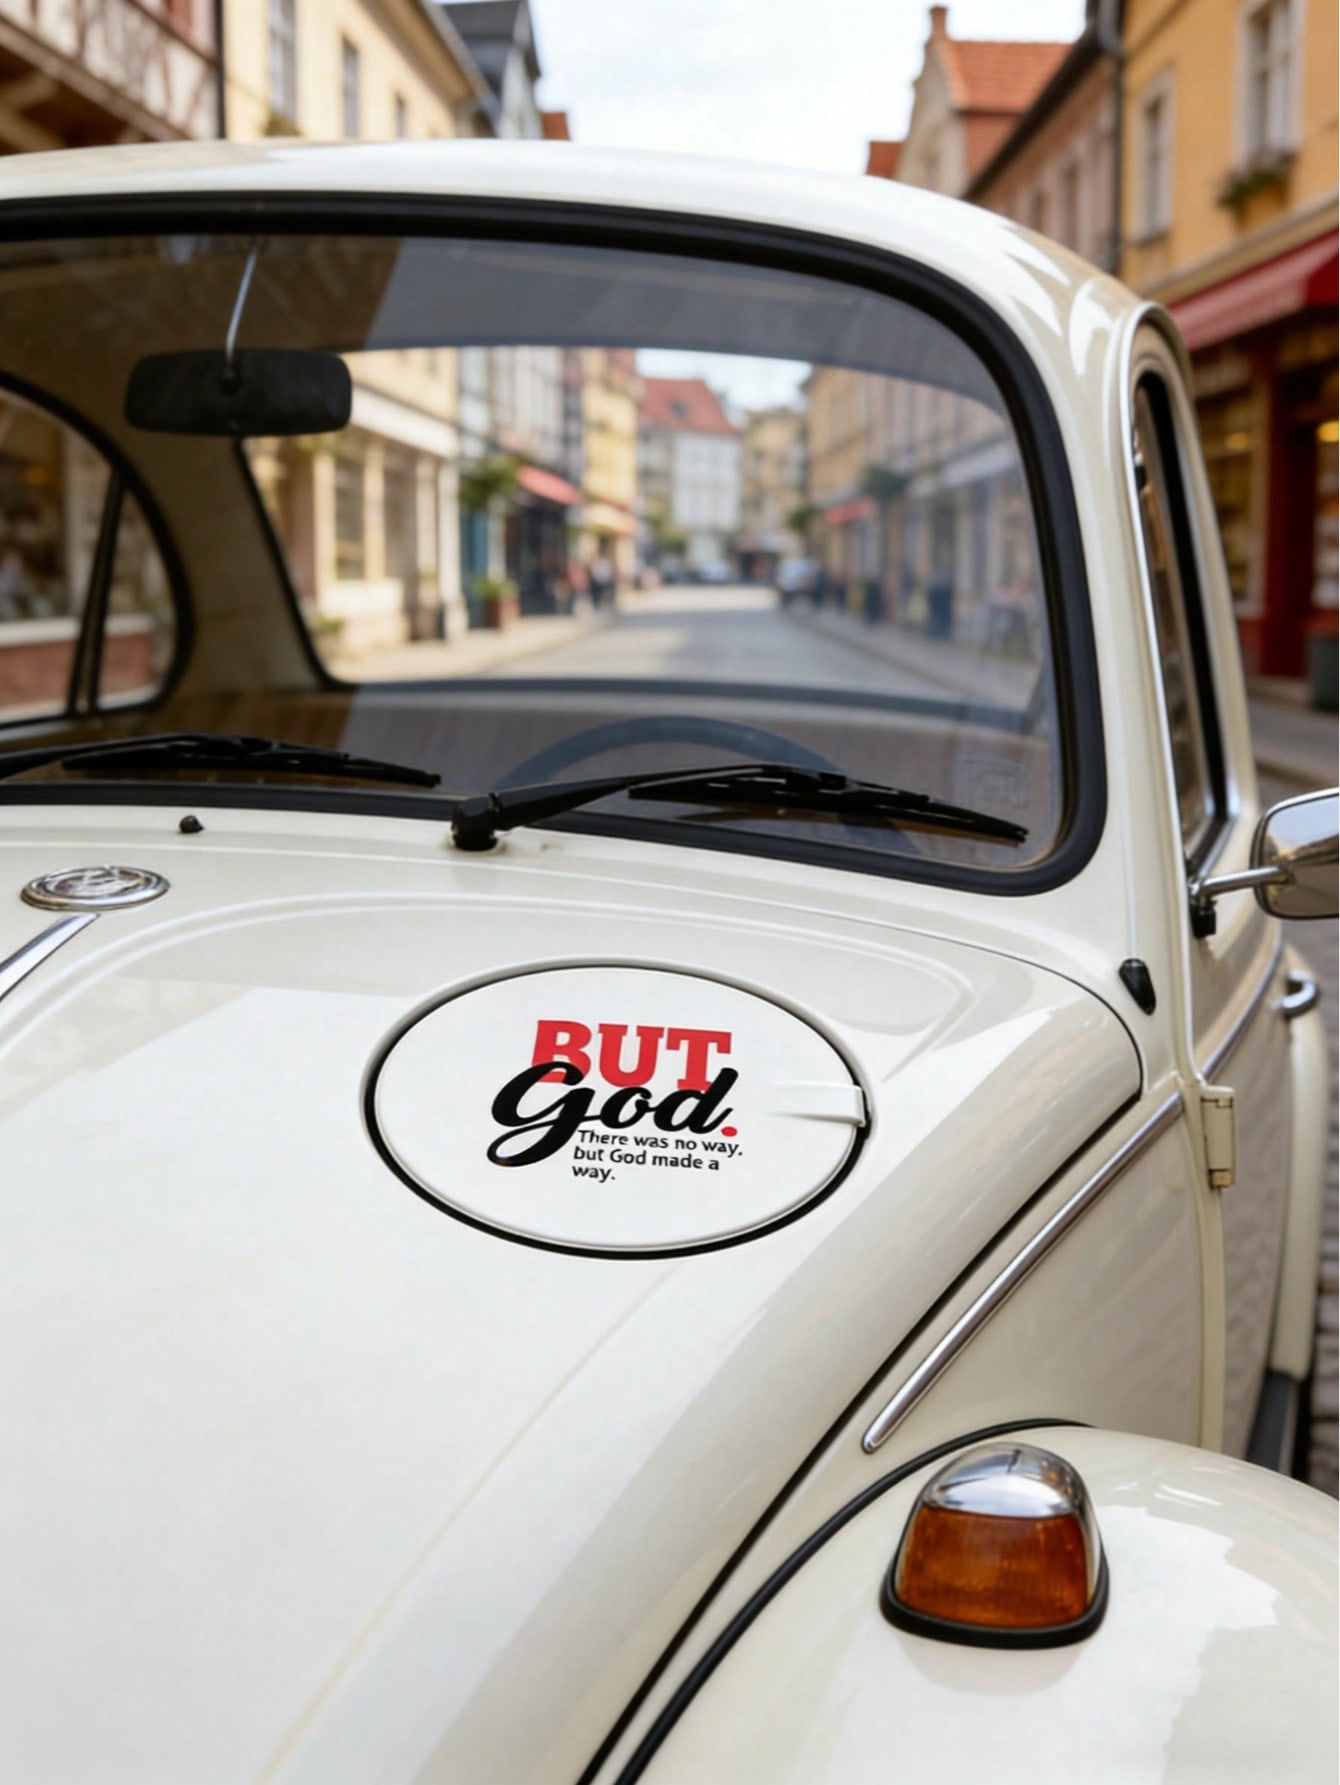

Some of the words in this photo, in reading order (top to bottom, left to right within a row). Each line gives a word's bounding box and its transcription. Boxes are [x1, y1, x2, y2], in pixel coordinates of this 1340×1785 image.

[531, 1019, 732, 1093] BUT
[486, 1061, 739, 1168] God.
[577, 1129, 629, 1146] There
[633, 1135, 669, 1149] was
[675, 1138, 697, 1151] no
[573, 1145, 604, 1162] but
[609, 1148, 647, 1166] God
[652, 1153, 704, 1169] made
[708, 1159, 720, 1171] a
[572, 1165, 616, 1183] way.
